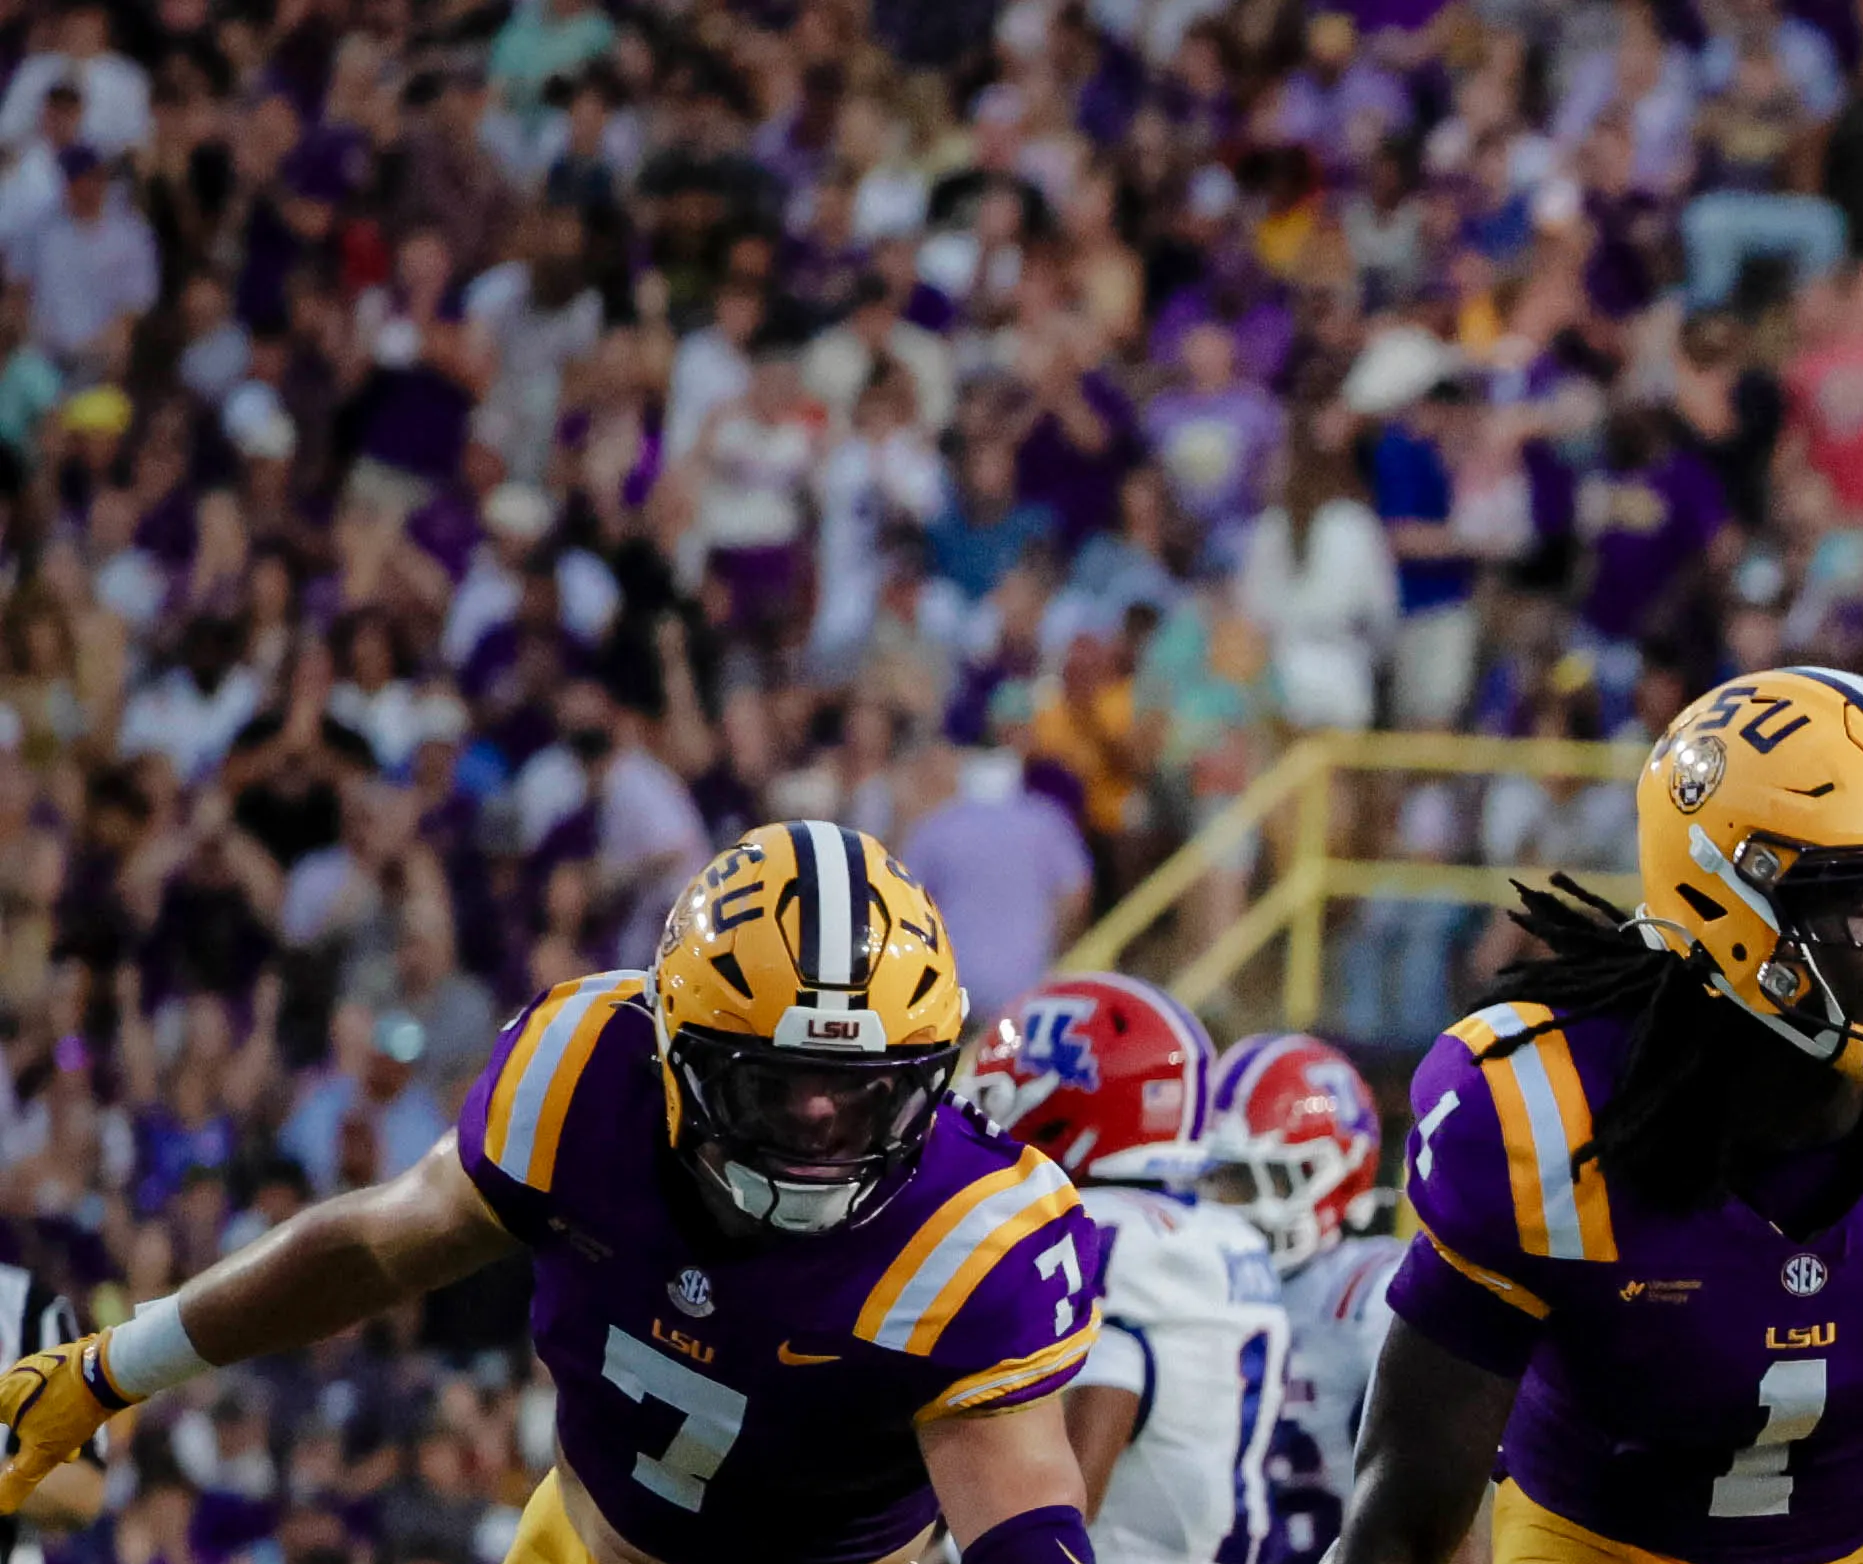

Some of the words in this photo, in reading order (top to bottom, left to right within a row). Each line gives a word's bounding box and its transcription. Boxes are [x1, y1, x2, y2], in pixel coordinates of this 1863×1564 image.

[1660, 686, 1812, 758] SU
[703, 842, 767, 936] SU
[807, 1019, 860, 1039] LSU
[678, 1268, 711, 1305] SEC
[1033, 1231, 1084, 1338] 7
[1785, 1256, 1826, 1294] SEC
[652, 1317, 716, 1364] LSU
[1765, 1321, 1837, 1350] LSU
[601, 1323, 748, 1514] 7
[1708, 1357, 1828, 1517] 1
